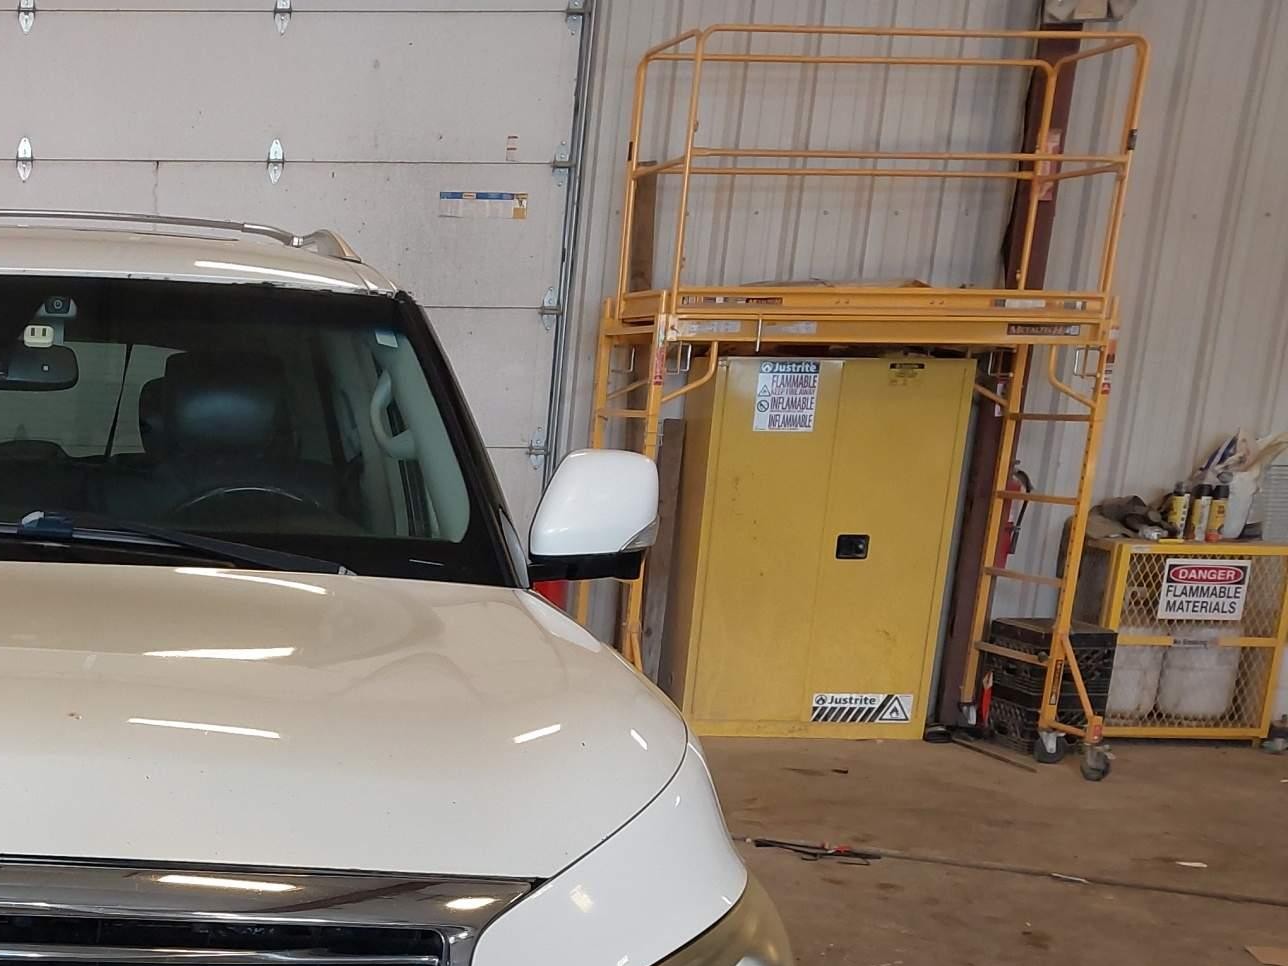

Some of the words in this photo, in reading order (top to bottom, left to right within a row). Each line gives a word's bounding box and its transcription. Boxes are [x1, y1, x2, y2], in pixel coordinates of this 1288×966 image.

[774, 362, 817, 373] Justrite
[772, 374, 818, 388] FLAMMABLE
[770, 397, 815, 411] INFLAMABLE
[768, 414, 813, 428] INFLAMMABLE
[1178, 569, 1236, 580] DANGER
[1165, 585, 1242, 599] FLAMMABLE
[1165, 601, 1237, 614] MATERIALS
[828, 695, 876, 705] Justrite
